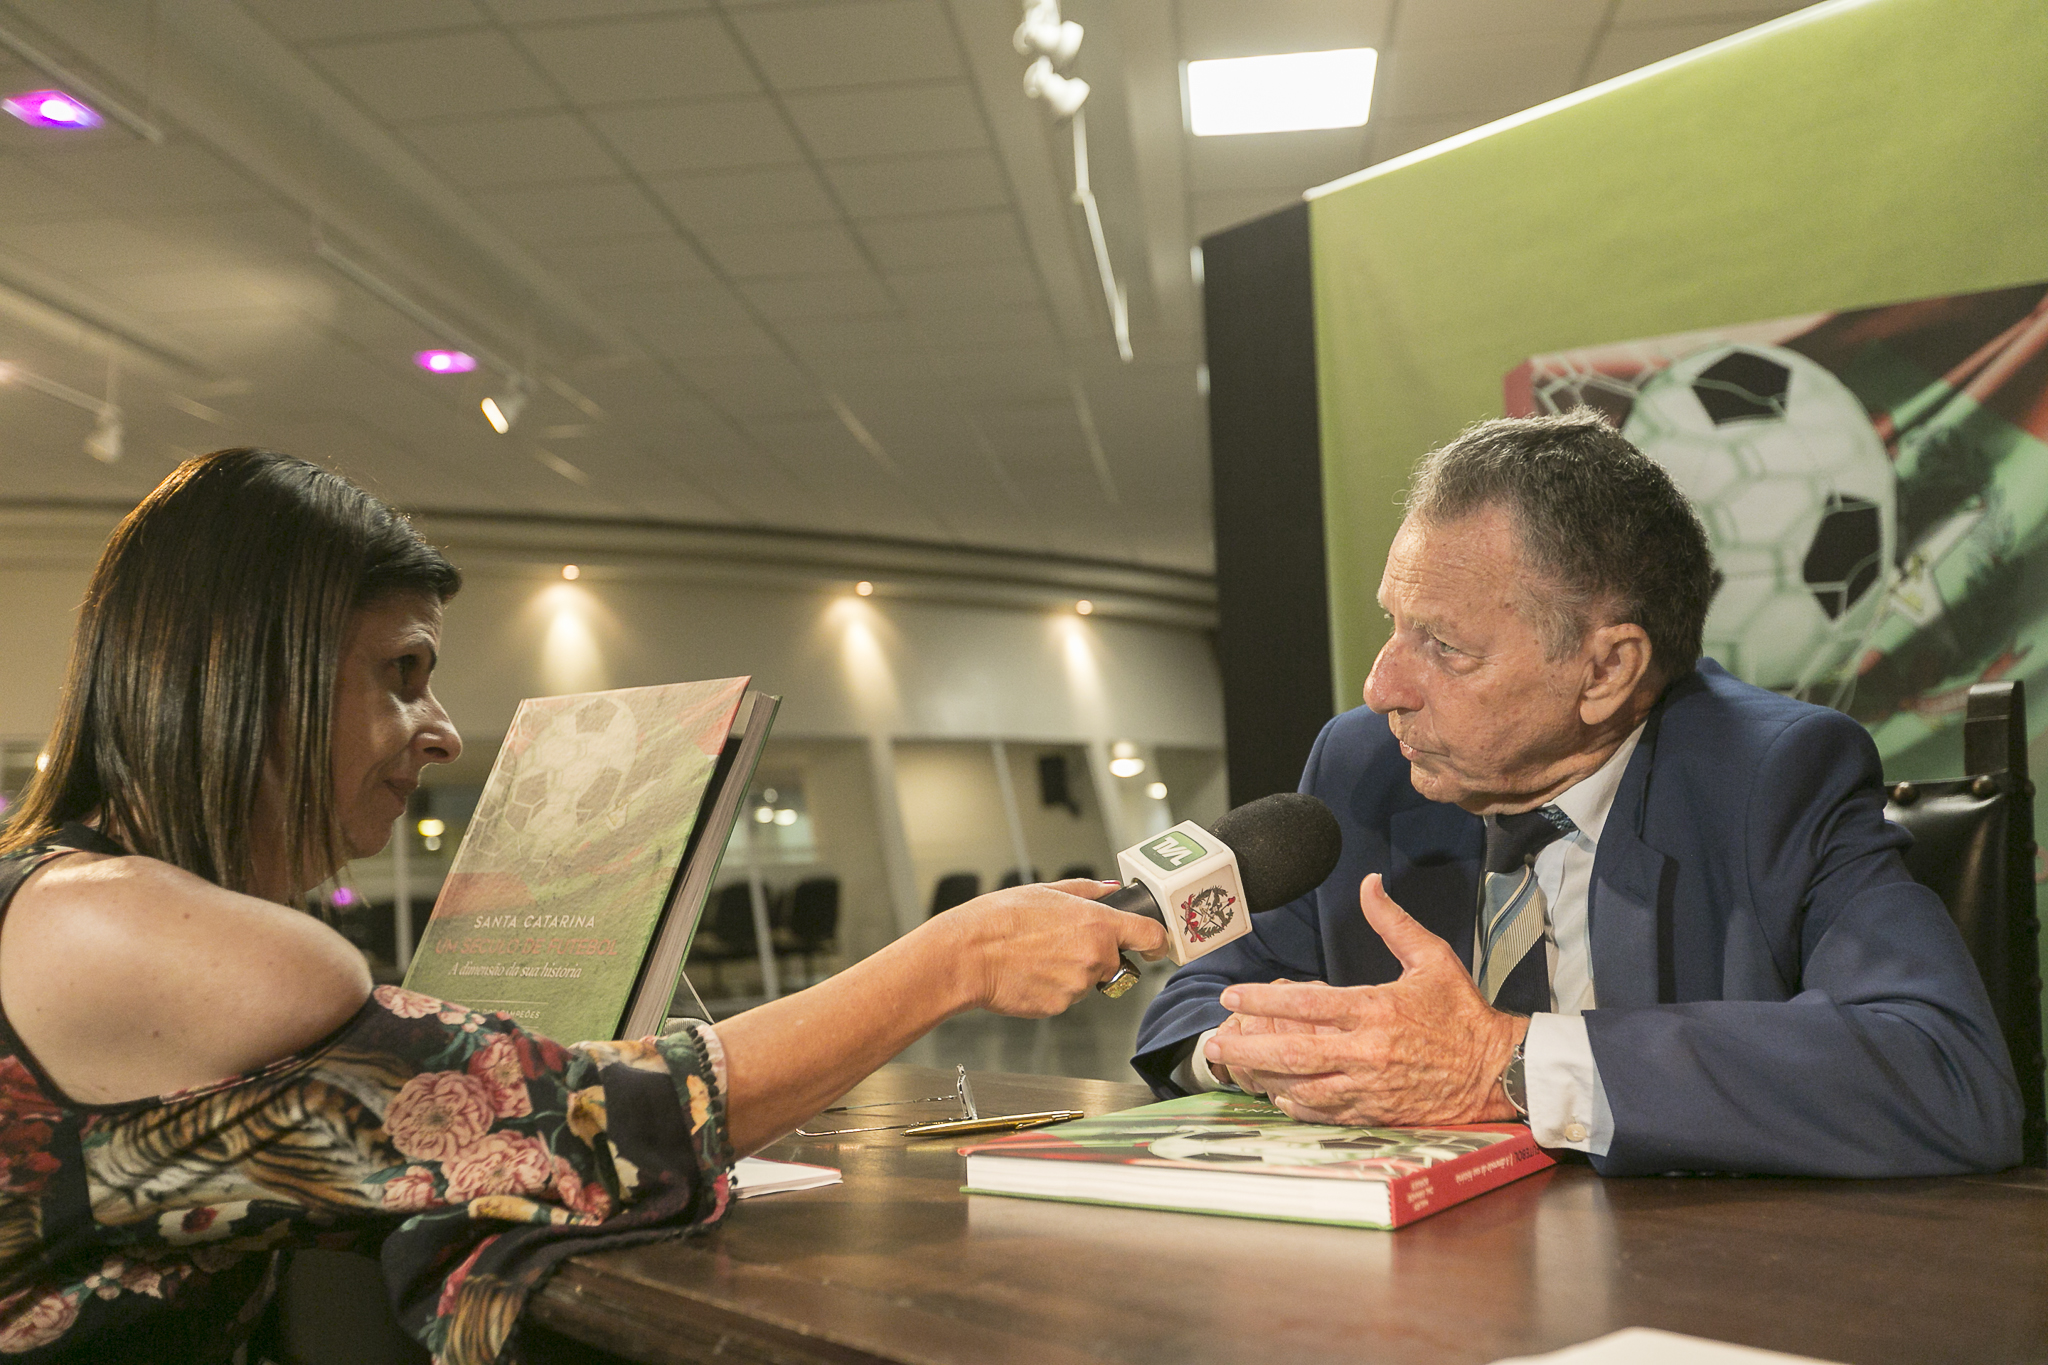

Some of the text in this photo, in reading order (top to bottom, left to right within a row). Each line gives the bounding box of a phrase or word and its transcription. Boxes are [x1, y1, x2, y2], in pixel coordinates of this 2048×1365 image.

[473, 914, 596, 930] SANTA CATARINA
[435, 938, 459, 955] UM
[521, 937, 546, 955] DE
[546, 937, 618, 956] FUTEBOL
[447, 960, 582, 979] A dimensão da sua história
